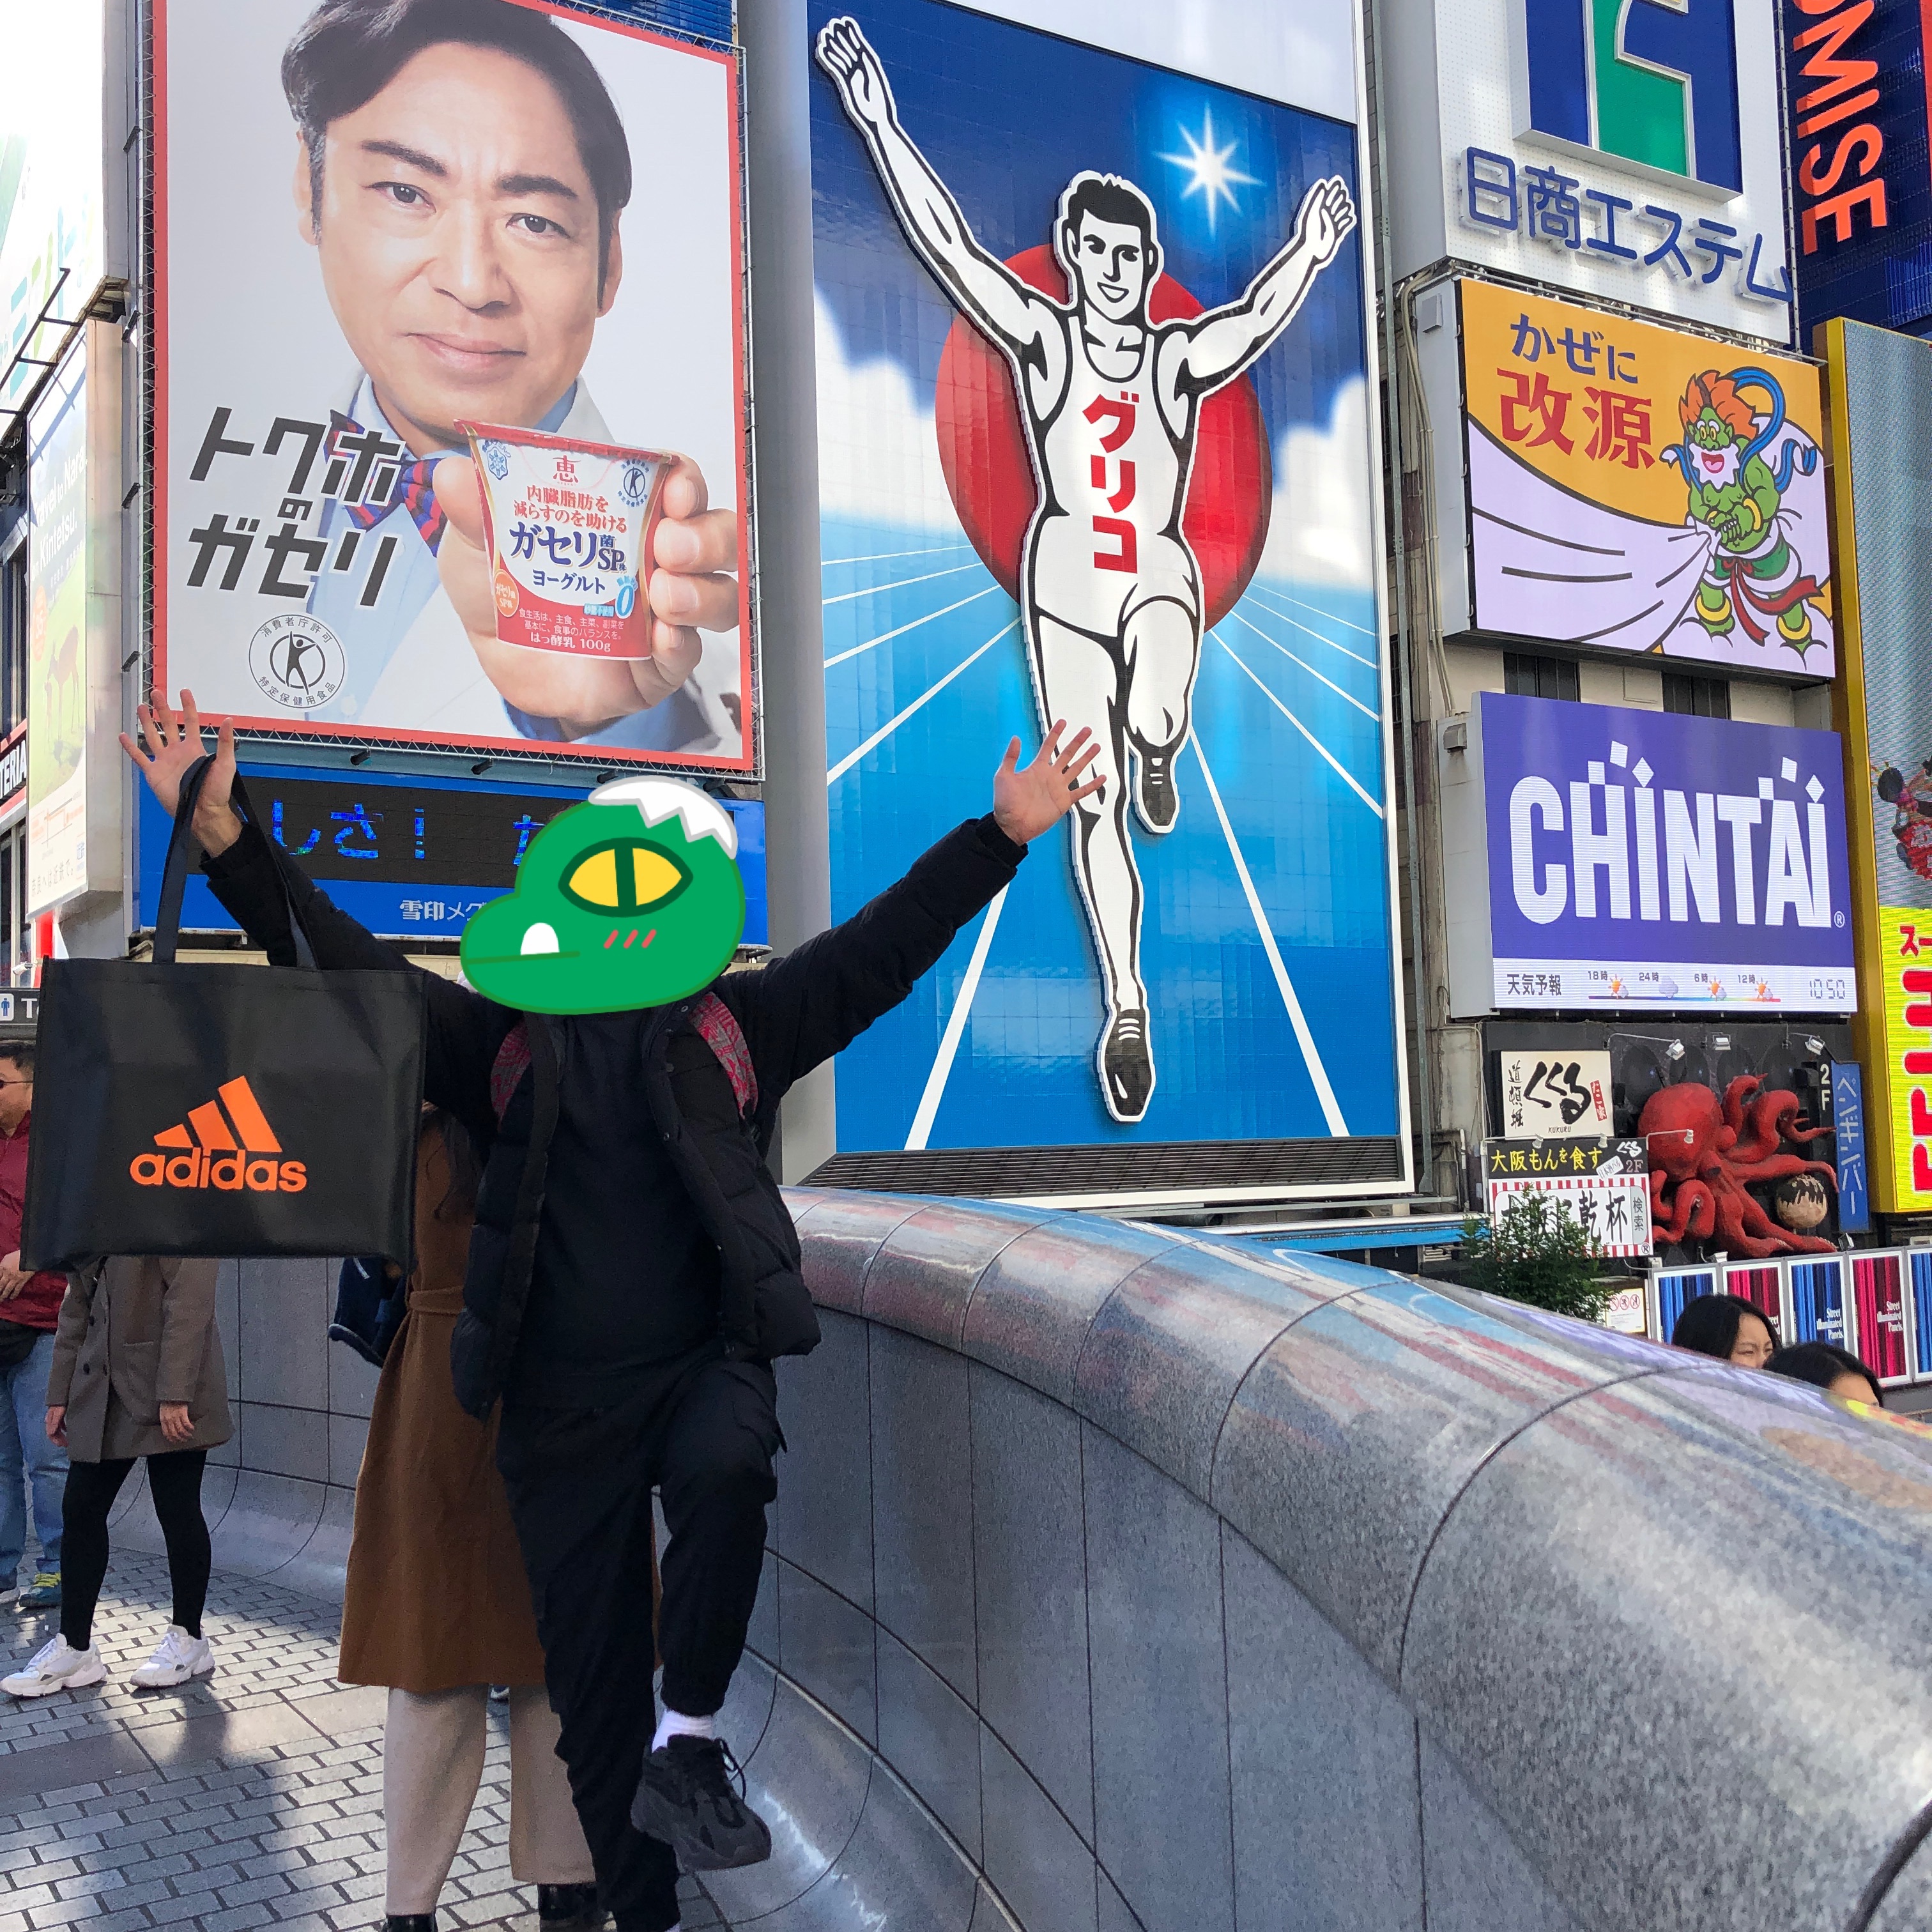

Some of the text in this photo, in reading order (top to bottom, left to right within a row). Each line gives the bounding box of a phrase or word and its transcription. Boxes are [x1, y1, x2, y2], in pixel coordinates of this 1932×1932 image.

[1465, 146, 1793, 303] 日商エステム
[1510, 313, 1639, 384] かぜに
[1497, 367, 1655, 470] 改源
[189, 406, 401, 503] トクホ
[553, 455, 581, 483] 恵
[1082, 390, 1140, 574] グリコ
[277, 498, 314, 521] の
[527, 485, 609, 513] 内臓脂肪を
[514, 500, 627, 533] 減らすのを助ける
[187, 514, 398, 607] ガセリ
[532, 569, 605, 594] ヨーグルト
[259, 617, 333, 643] 消費者庁許可
[530, 632, 611, 652] はっ酵乳 100g
[259, 676, 336, 706] 特定保健用食品
[1509, 740, 1832, 929] CHINTAI
[1507, 973, 1561, 997] 天気予報
[1588, 970, 1608, 981] 18時
[1639, 972, 1659, 982] 24時
[1694, 973, 1708, 983] 6時
[1737, 974, 1756, 985] 12時
[1508, 1059, 1523, 1129] 道頓堀
[1523, 1061, 1591, 1125] くくる
[1820, 1064, 1830, 1110] 2F
[1491, 1146, 1602, 1172] 大阪もんを食す
[1616, 1140, 1643, 1158] くくる
[1837, 1077, 1862, 1215] ペンギンバー
[130, 1147, 307, 1192] adidas
[1626, 1160, 1644, 1173] 2F
[1633, 1197, 1644, 1232] 検索
